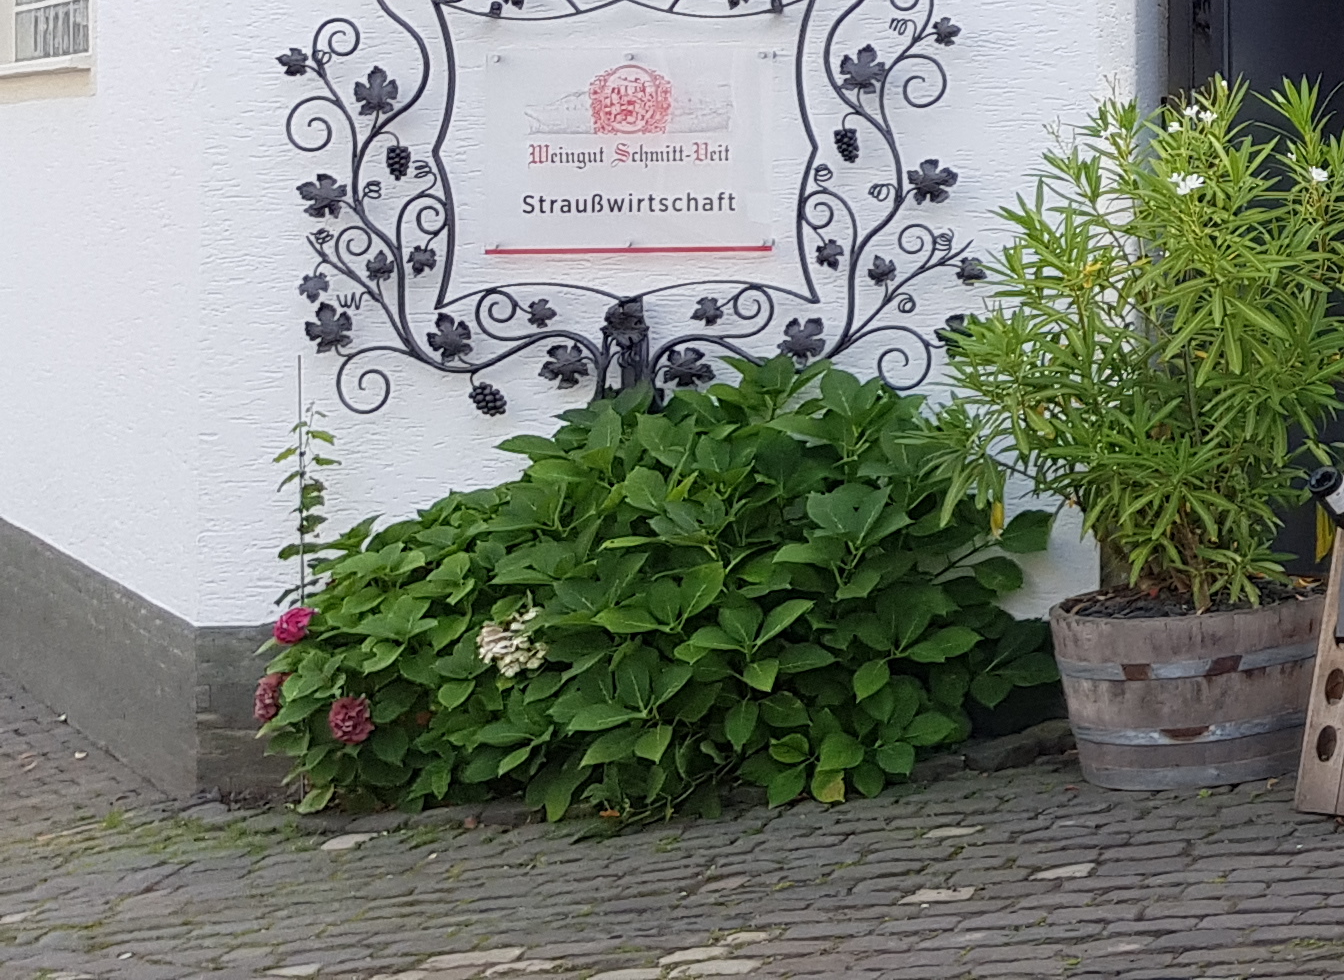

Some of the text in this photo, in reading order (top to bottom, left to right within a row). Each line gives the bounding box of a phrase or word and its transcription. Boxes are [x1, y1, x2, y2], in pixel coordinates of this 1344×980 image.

[528, 141, 730, 169] Weingut Schmitt-Veit
[522, 192, 736, 214] Straußwirtschaft
